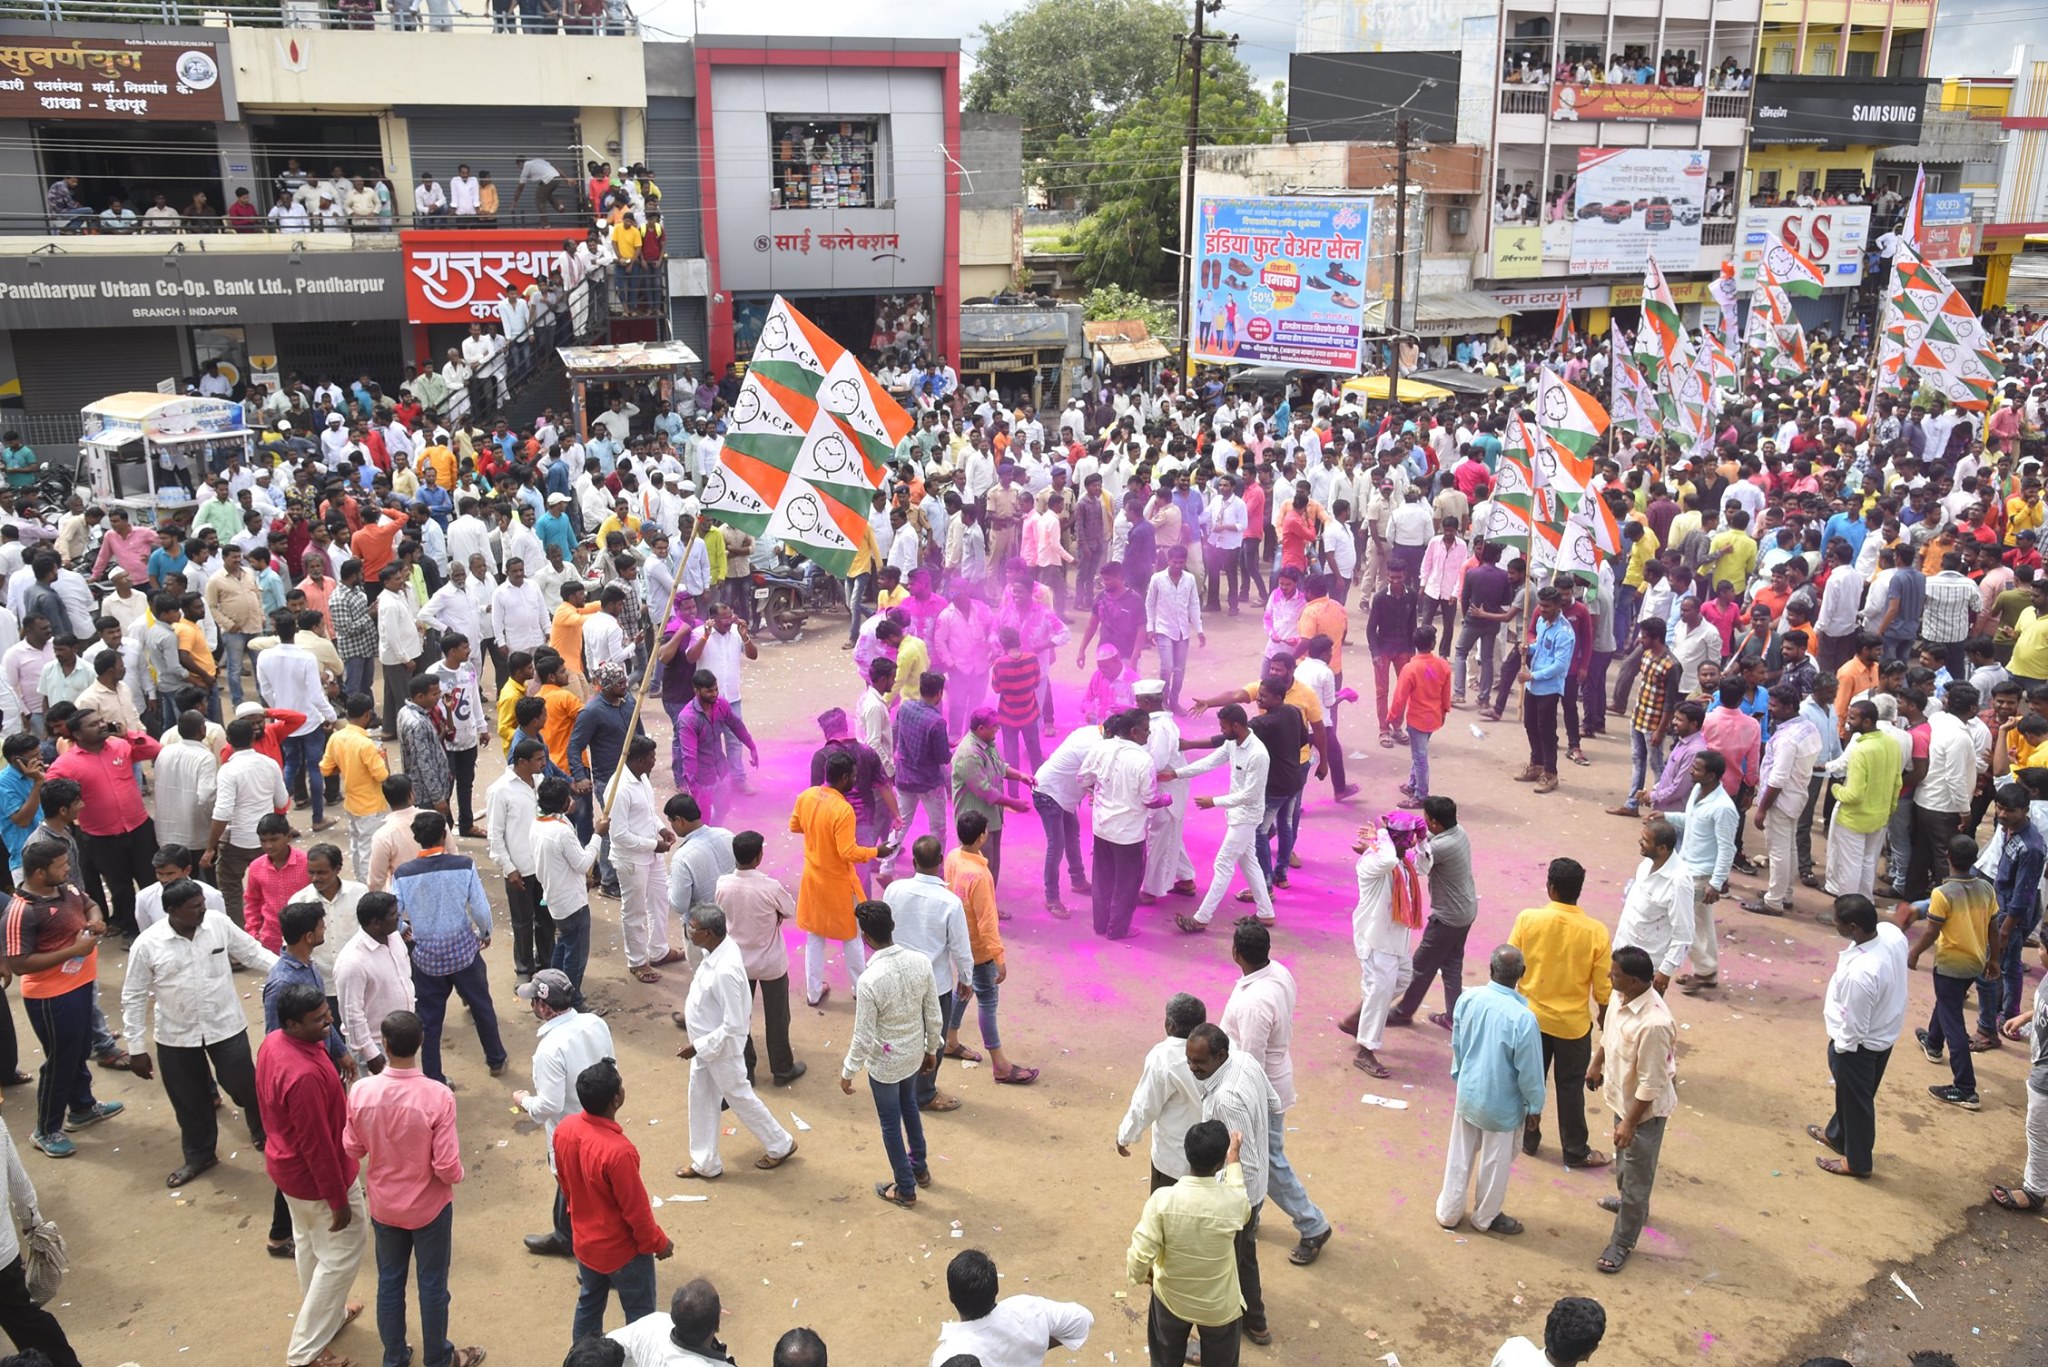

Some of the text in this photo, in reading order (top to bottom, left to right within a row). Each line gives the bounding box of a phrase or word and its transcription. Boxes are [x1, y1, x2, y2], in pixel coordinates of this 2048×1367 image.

[33, 78, 83, 93] पतसंस्था
[92, 80, 120, 94] मर्या.
[123, 80, 168, 94] निमगांव
[41, 96, 82, 110] शाखा
[105, 94, 148, 114] इंदापूर
[1851, 104, 1917, 122] SAMSUNG
[774, 228, 900, 255] साई कलेक्शन
[1205, 228, 1362, 262] इंडिया फुट वेअर सेल
[0, 276, 385, 300] Pandharpur Urban Co-Op. Bank Ltd., Pandharpur
[1263, 273, 1298, 289] धमाका
[1252, 291, 1272, 304] 50%
[132, 307, 180, 317] BRANCH
[188, 306, 238, 317] INDAPUR
[789, 342, 818, 371] N.C.P.
[759, 411, 793, 434] N.C.P.
[857, 410, 884, 440] N.C.P.
[727, 490, 761, 512] N.C.P.
[814, 522, 846, 546] N.C.P.
